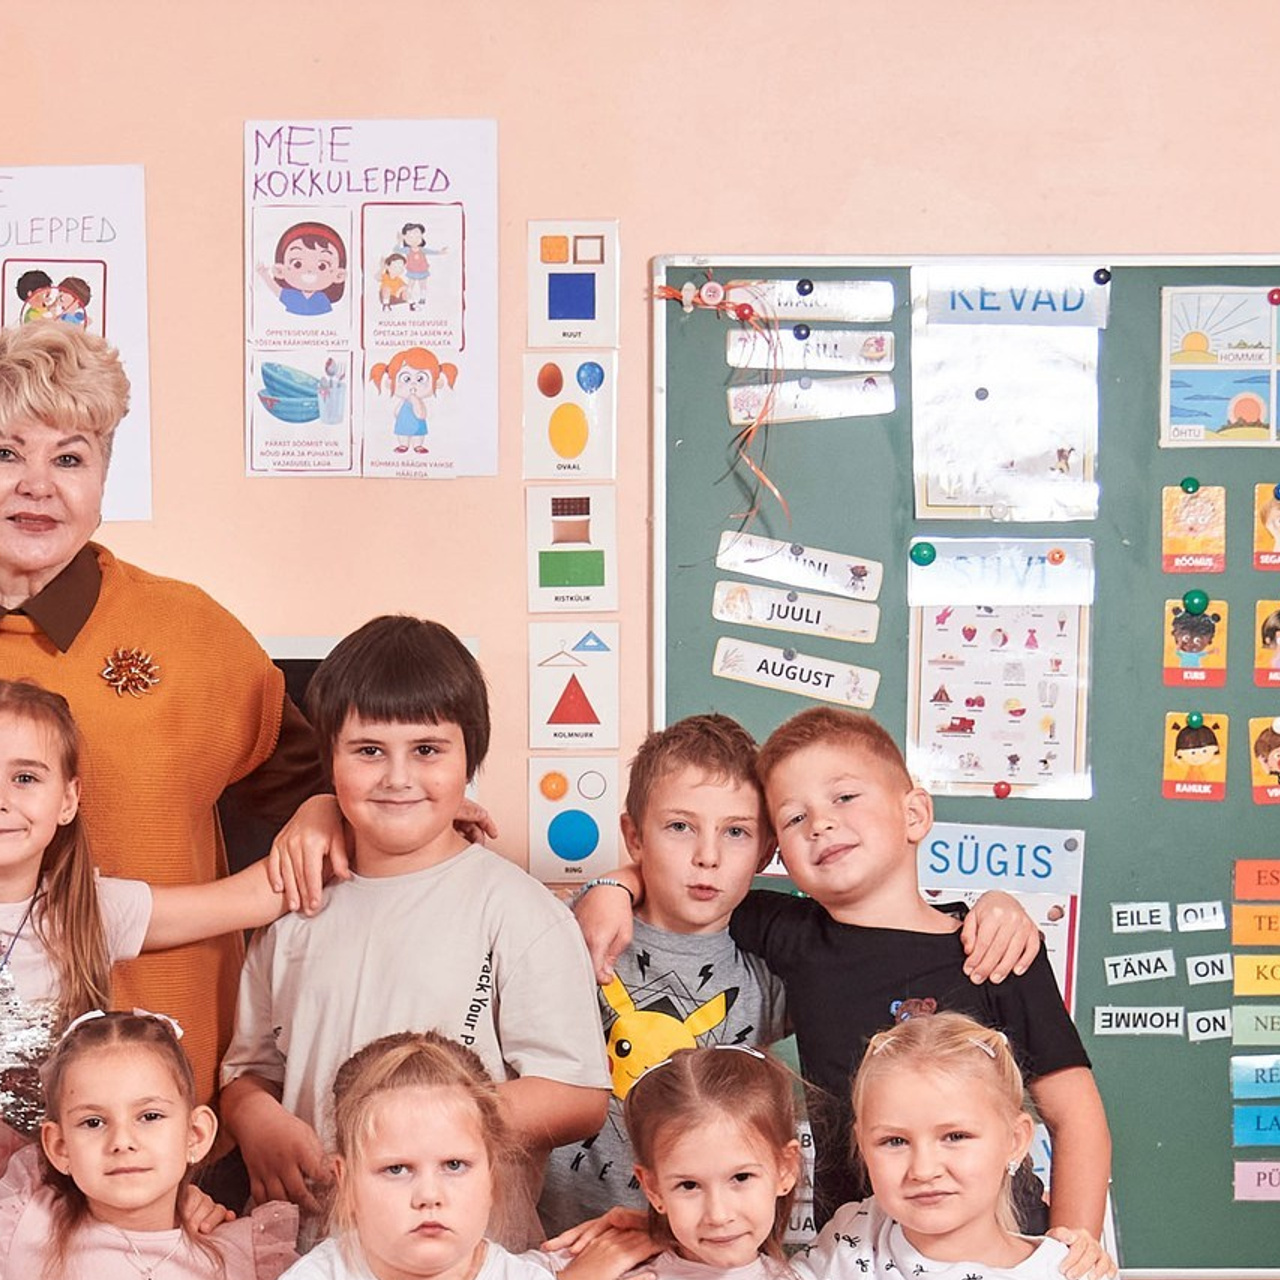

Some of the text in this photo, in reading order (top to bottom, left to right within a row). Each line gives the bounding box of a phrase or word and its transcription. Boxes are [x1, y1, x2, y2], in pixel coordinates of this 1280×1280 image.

[254, 126, 353, 166] MEIE
[253, 165, 450, 200] KOKKULEPPED
[562, 331, 582, 339] RUUT
[1220, 352, 1265, 362] HOMMIK
[1172, 426, 1202, 438] ÕHTU
[556, 463, 581, 471] OVAAL
[554, 593, 590, 602] RISTKÜLIK
[767, 602, 821, 625] JUULI
[756, 658, 835, 689] AUGUST
[553, 731, 594, 739] KOLMNURK
[929, 835, 1054, 879] SÜGIS
[564, 866, 583, 874] RING
[1116, 909, 1162, 927] EILE
[1109, 957, 1225, 979] TÄNA ON
[464, 997, 489, 1031] Your
[1101, 1012, 1226, 1034] HOMME ON
